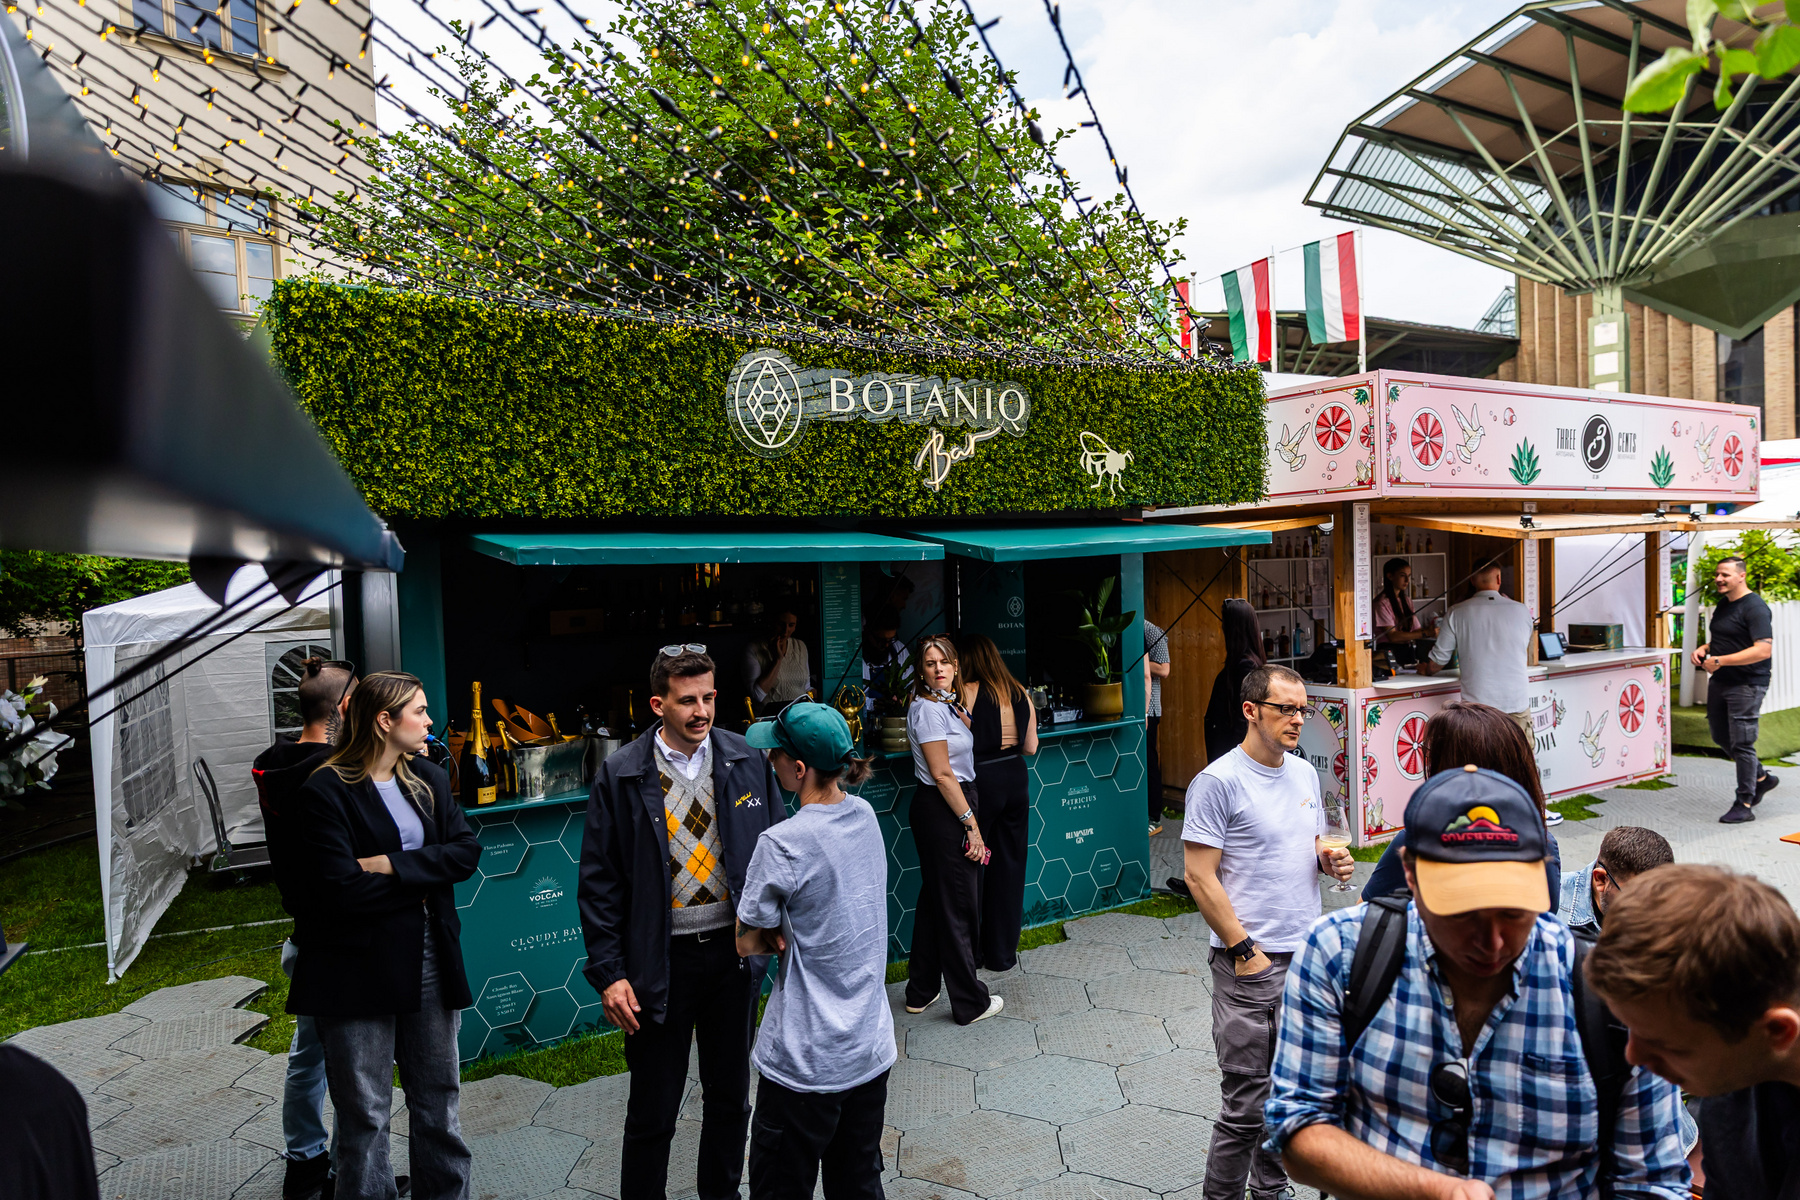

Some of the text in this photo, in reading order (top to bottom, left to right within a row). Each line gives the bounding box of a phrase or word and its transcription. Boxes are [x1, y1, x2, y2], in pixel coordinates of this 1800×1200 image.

[830, 377, 1026, 431] BOTANIQ
[1556, 428, 1576, 450] THREE
[1617, 432, 1637, 453] CENTS
[916, 427, 1002, 491] Bar
[1310, 754, 1328, 769] CENTS
[746, 797, 762, 808] XX
[1061, 795, 1097, 807] PATRICIUS
[529, 891, 563, 902] VOLCAN
[510, 926, 583, 947] CLOUDY BAY
[541, 936, 578, 947] ZEALAND
